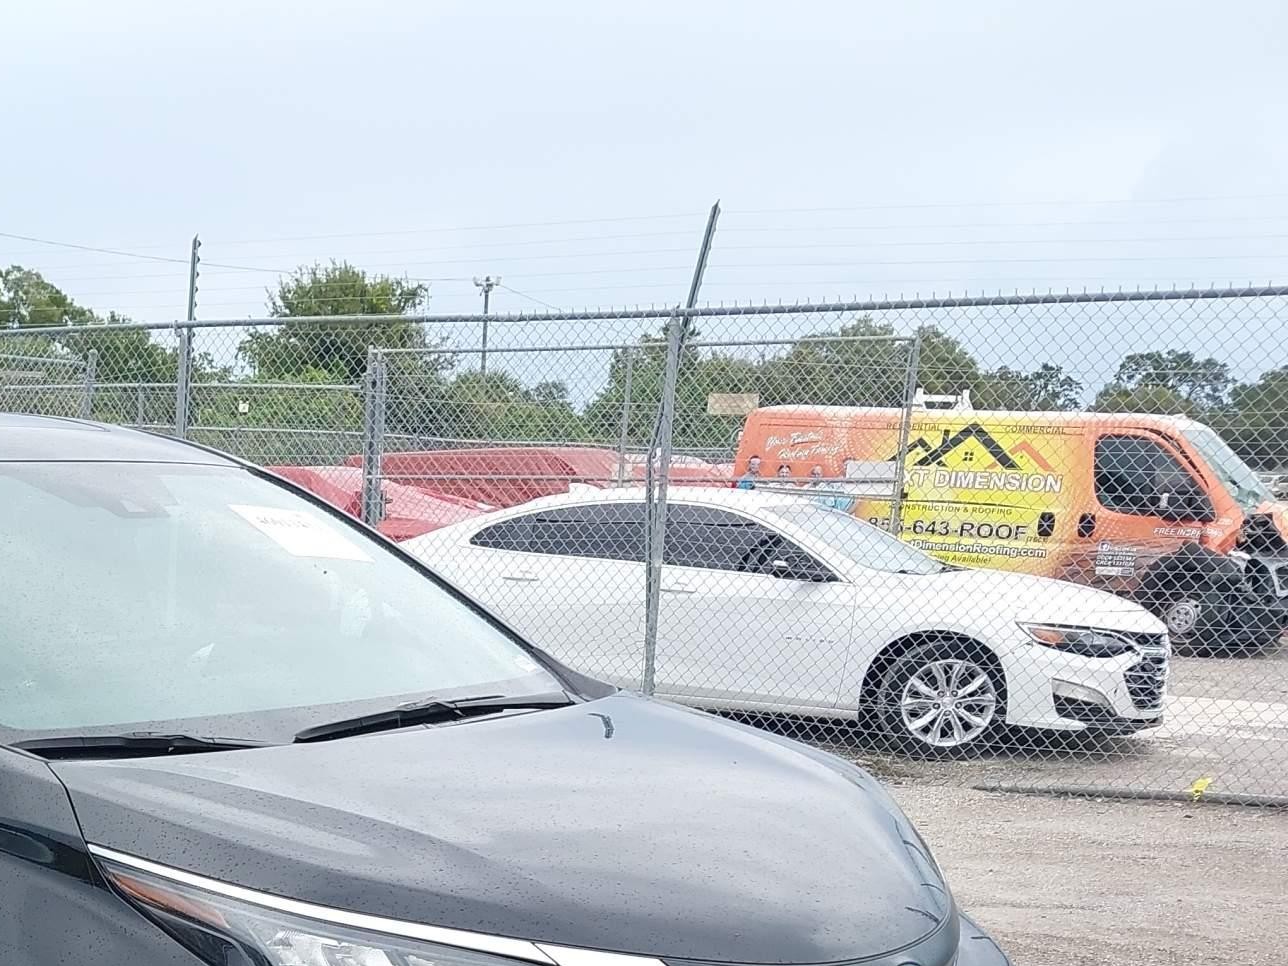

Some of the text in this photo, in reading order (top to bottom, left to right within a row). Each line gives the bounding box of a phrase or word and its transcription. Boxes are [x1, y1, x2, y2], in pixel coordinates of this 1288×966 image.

[1004, 425, 1066, 435] COMMERCIAL
[934, 469, 1063, 493] DIMENSION
[971, 506, 1013, 516] ROOFING
[1153, 527, 1175, 536] FREE
[950, 554, 992, 564] Available!
